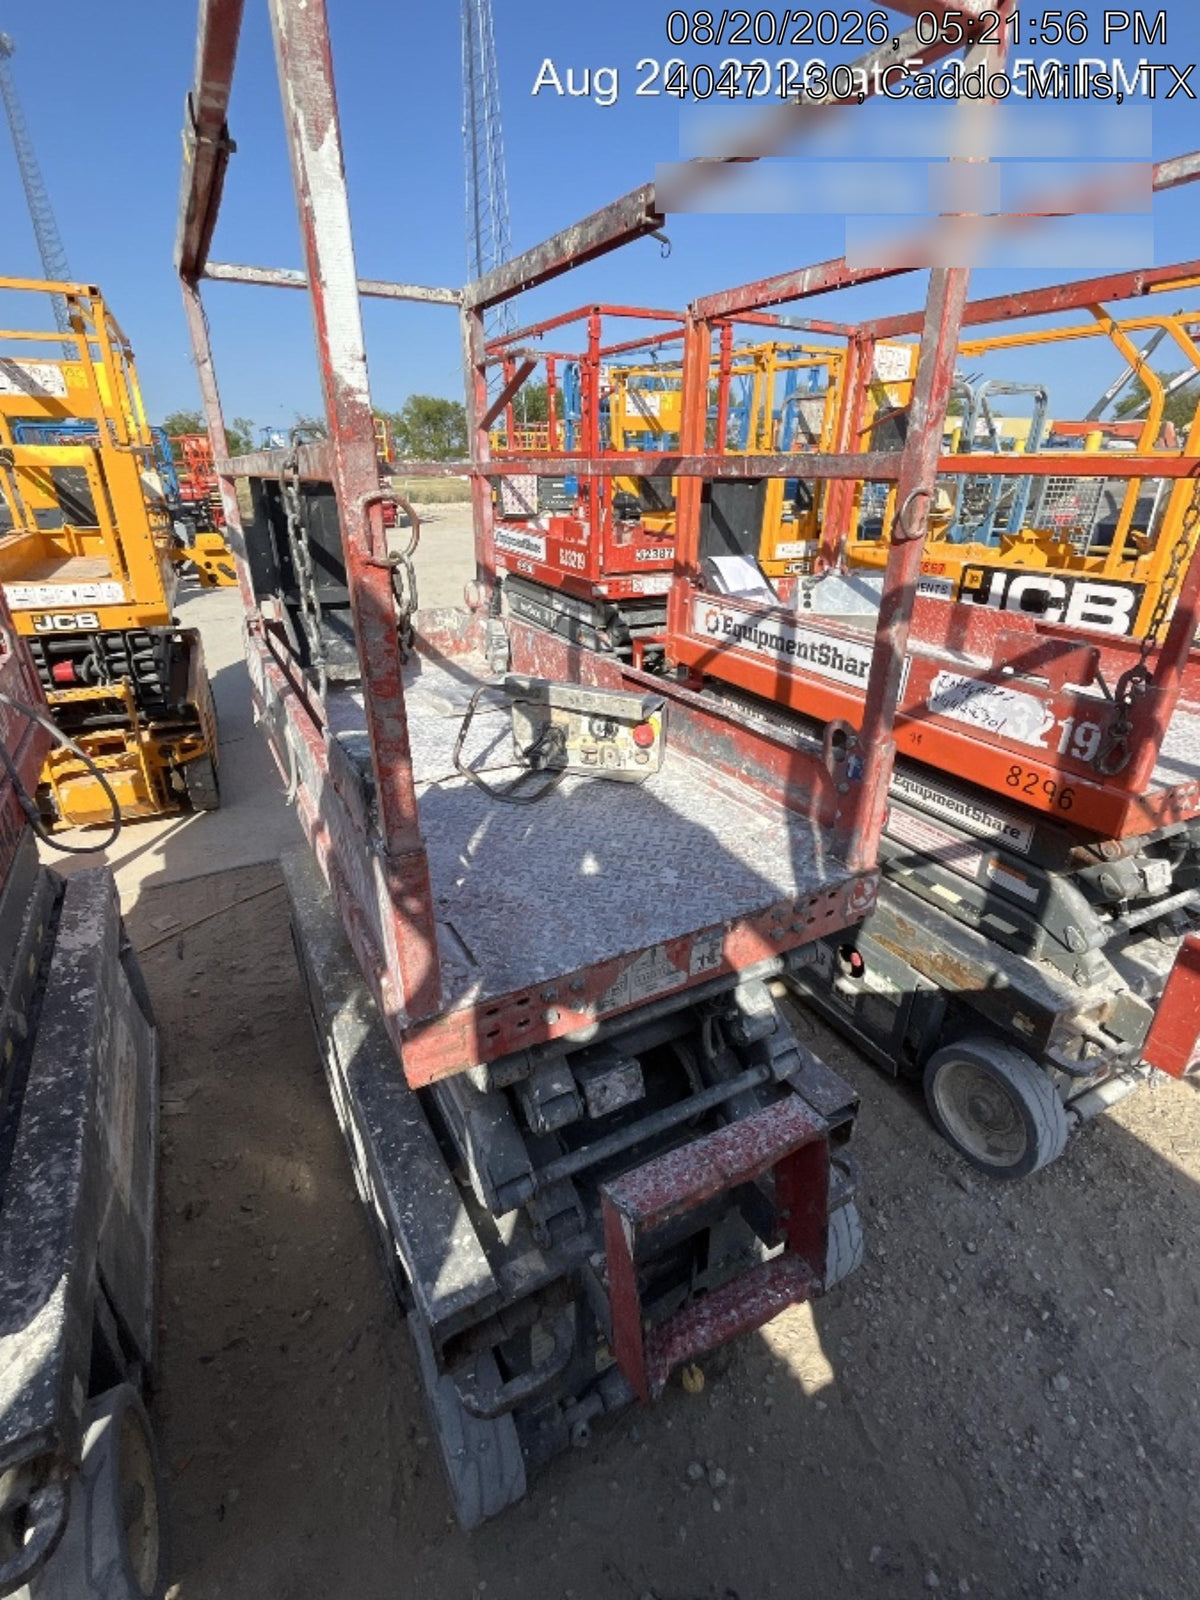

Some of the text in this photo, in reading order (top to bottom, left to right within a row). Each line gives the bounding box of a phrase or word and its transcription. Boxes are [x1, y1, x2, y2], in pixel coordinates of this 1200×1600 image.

[34, 612, 100, 631] JCB
[961, 571, 1135, 635] JCB
[721, 614, 870, 679] EquipmentShar
[893, 772, 1021, 840] EquipmentShare
[1005, 765, 1075, 810] 8296
